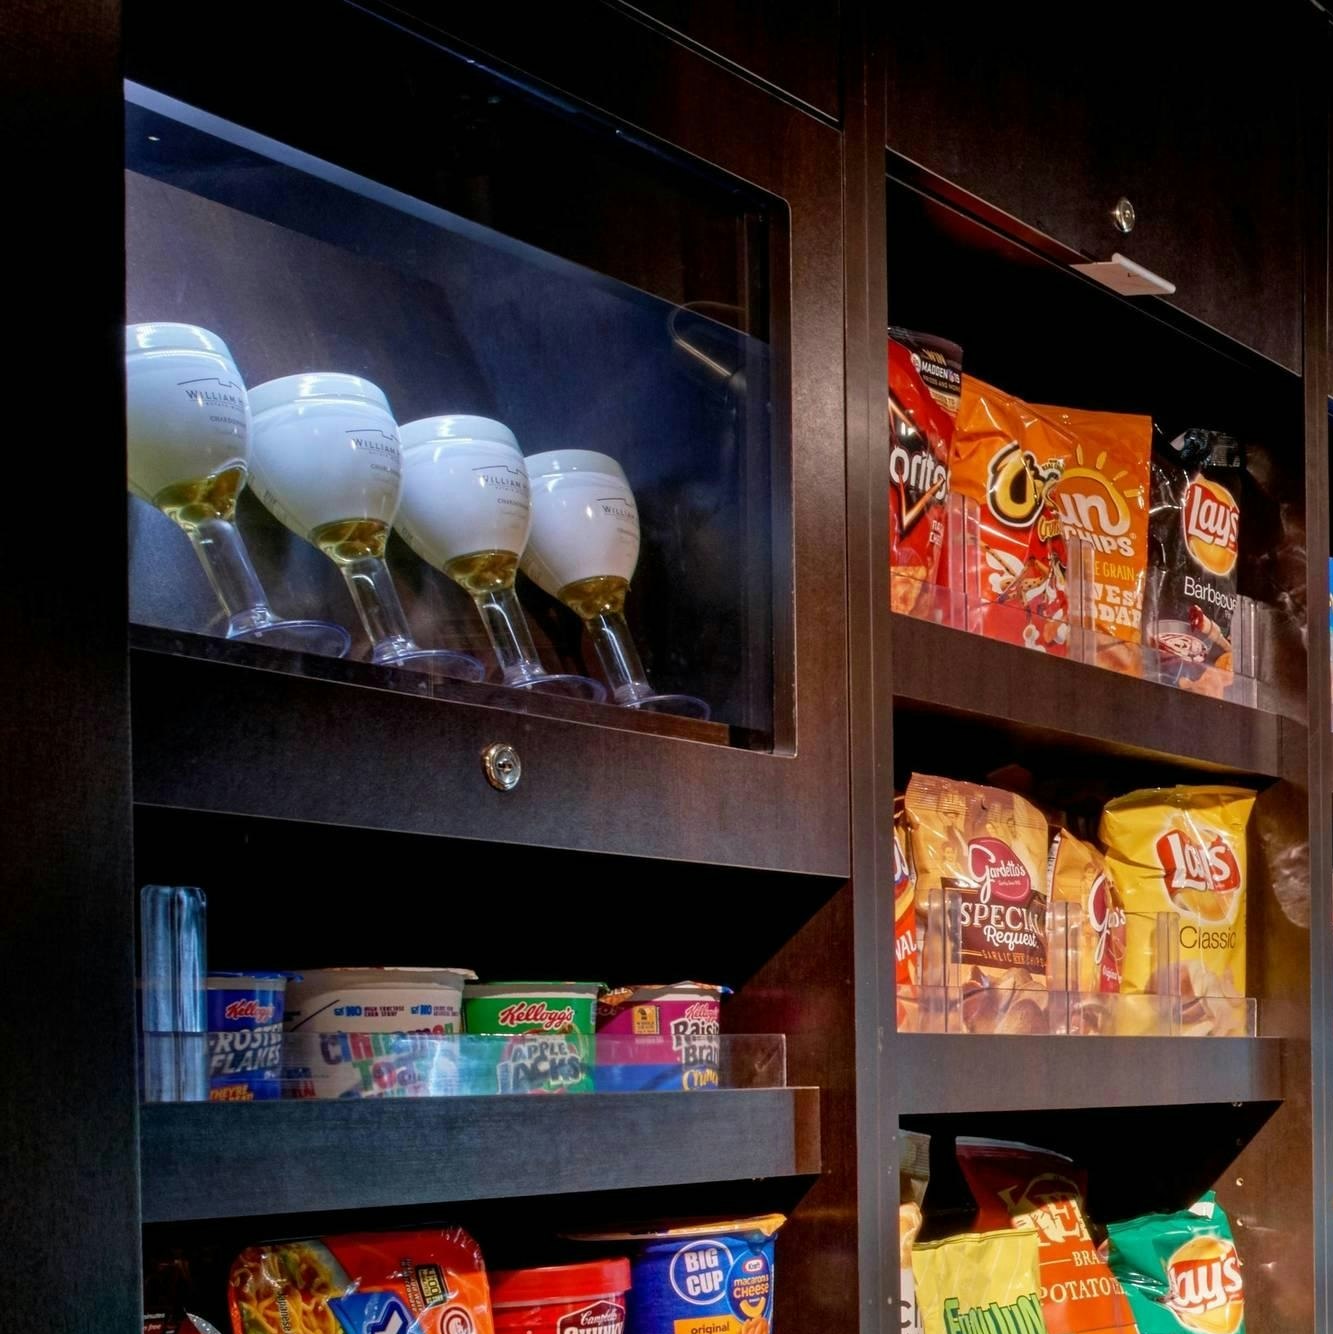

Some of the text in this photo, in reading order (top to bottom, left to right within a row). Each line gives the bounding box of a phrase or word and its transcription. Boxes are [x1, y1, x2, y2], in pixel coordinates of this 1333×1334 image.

[888, 446, 950, 500] orito
[1187, 486, 1240, 548] Lay's
[1103, 562, 1135, 582] GRAIN
[1184, 576, 1238, 611] Barbecue
[968, 844, 1026, 904] Gardetto's
[984, 925, 1037, 951] Request
[1178, 925, 1237, 951] Classic
[499, 1002, 575, 1030] Kellogg's
[684, 1247, 719, 1273] BIG
[685, 1271, 724, 1297] CUP
